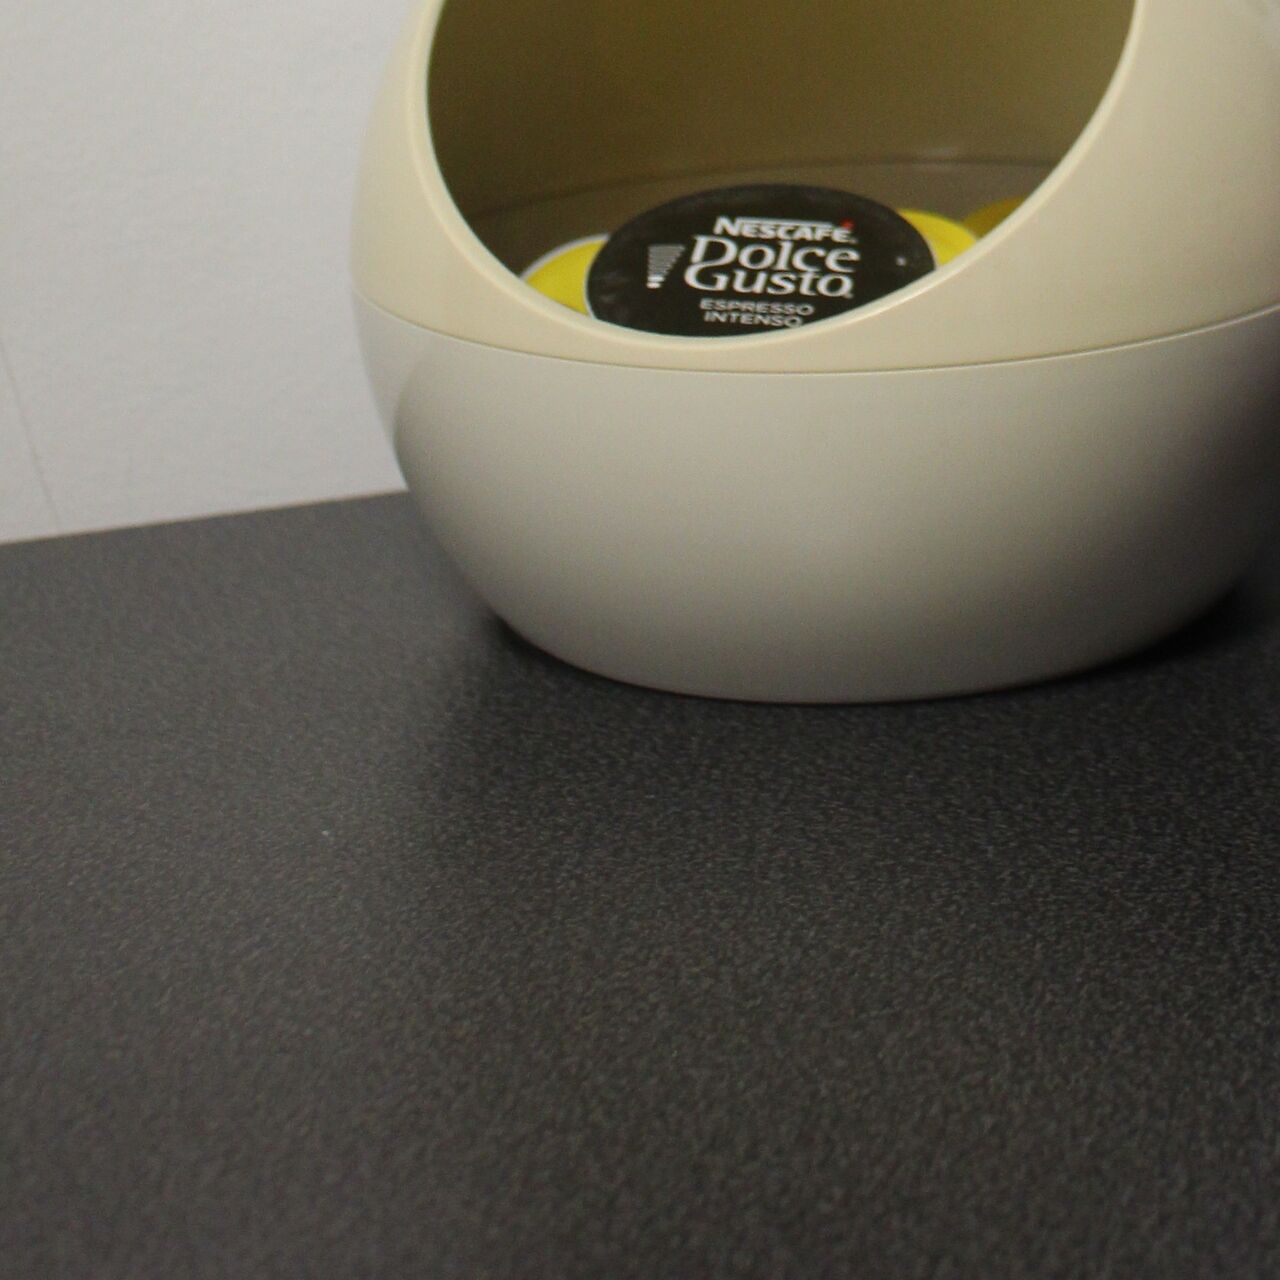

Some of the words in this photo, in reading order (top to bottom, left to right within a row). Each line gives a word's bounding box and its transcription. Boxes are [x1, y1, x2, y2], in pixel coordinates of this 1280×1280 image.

[689, 235, 860, 273] Dolce
[684, 269, 852, 298] Gusto
[700, 297, 814, 317] ESPRESSO
[703, 311, 803, 328] INTENSO
